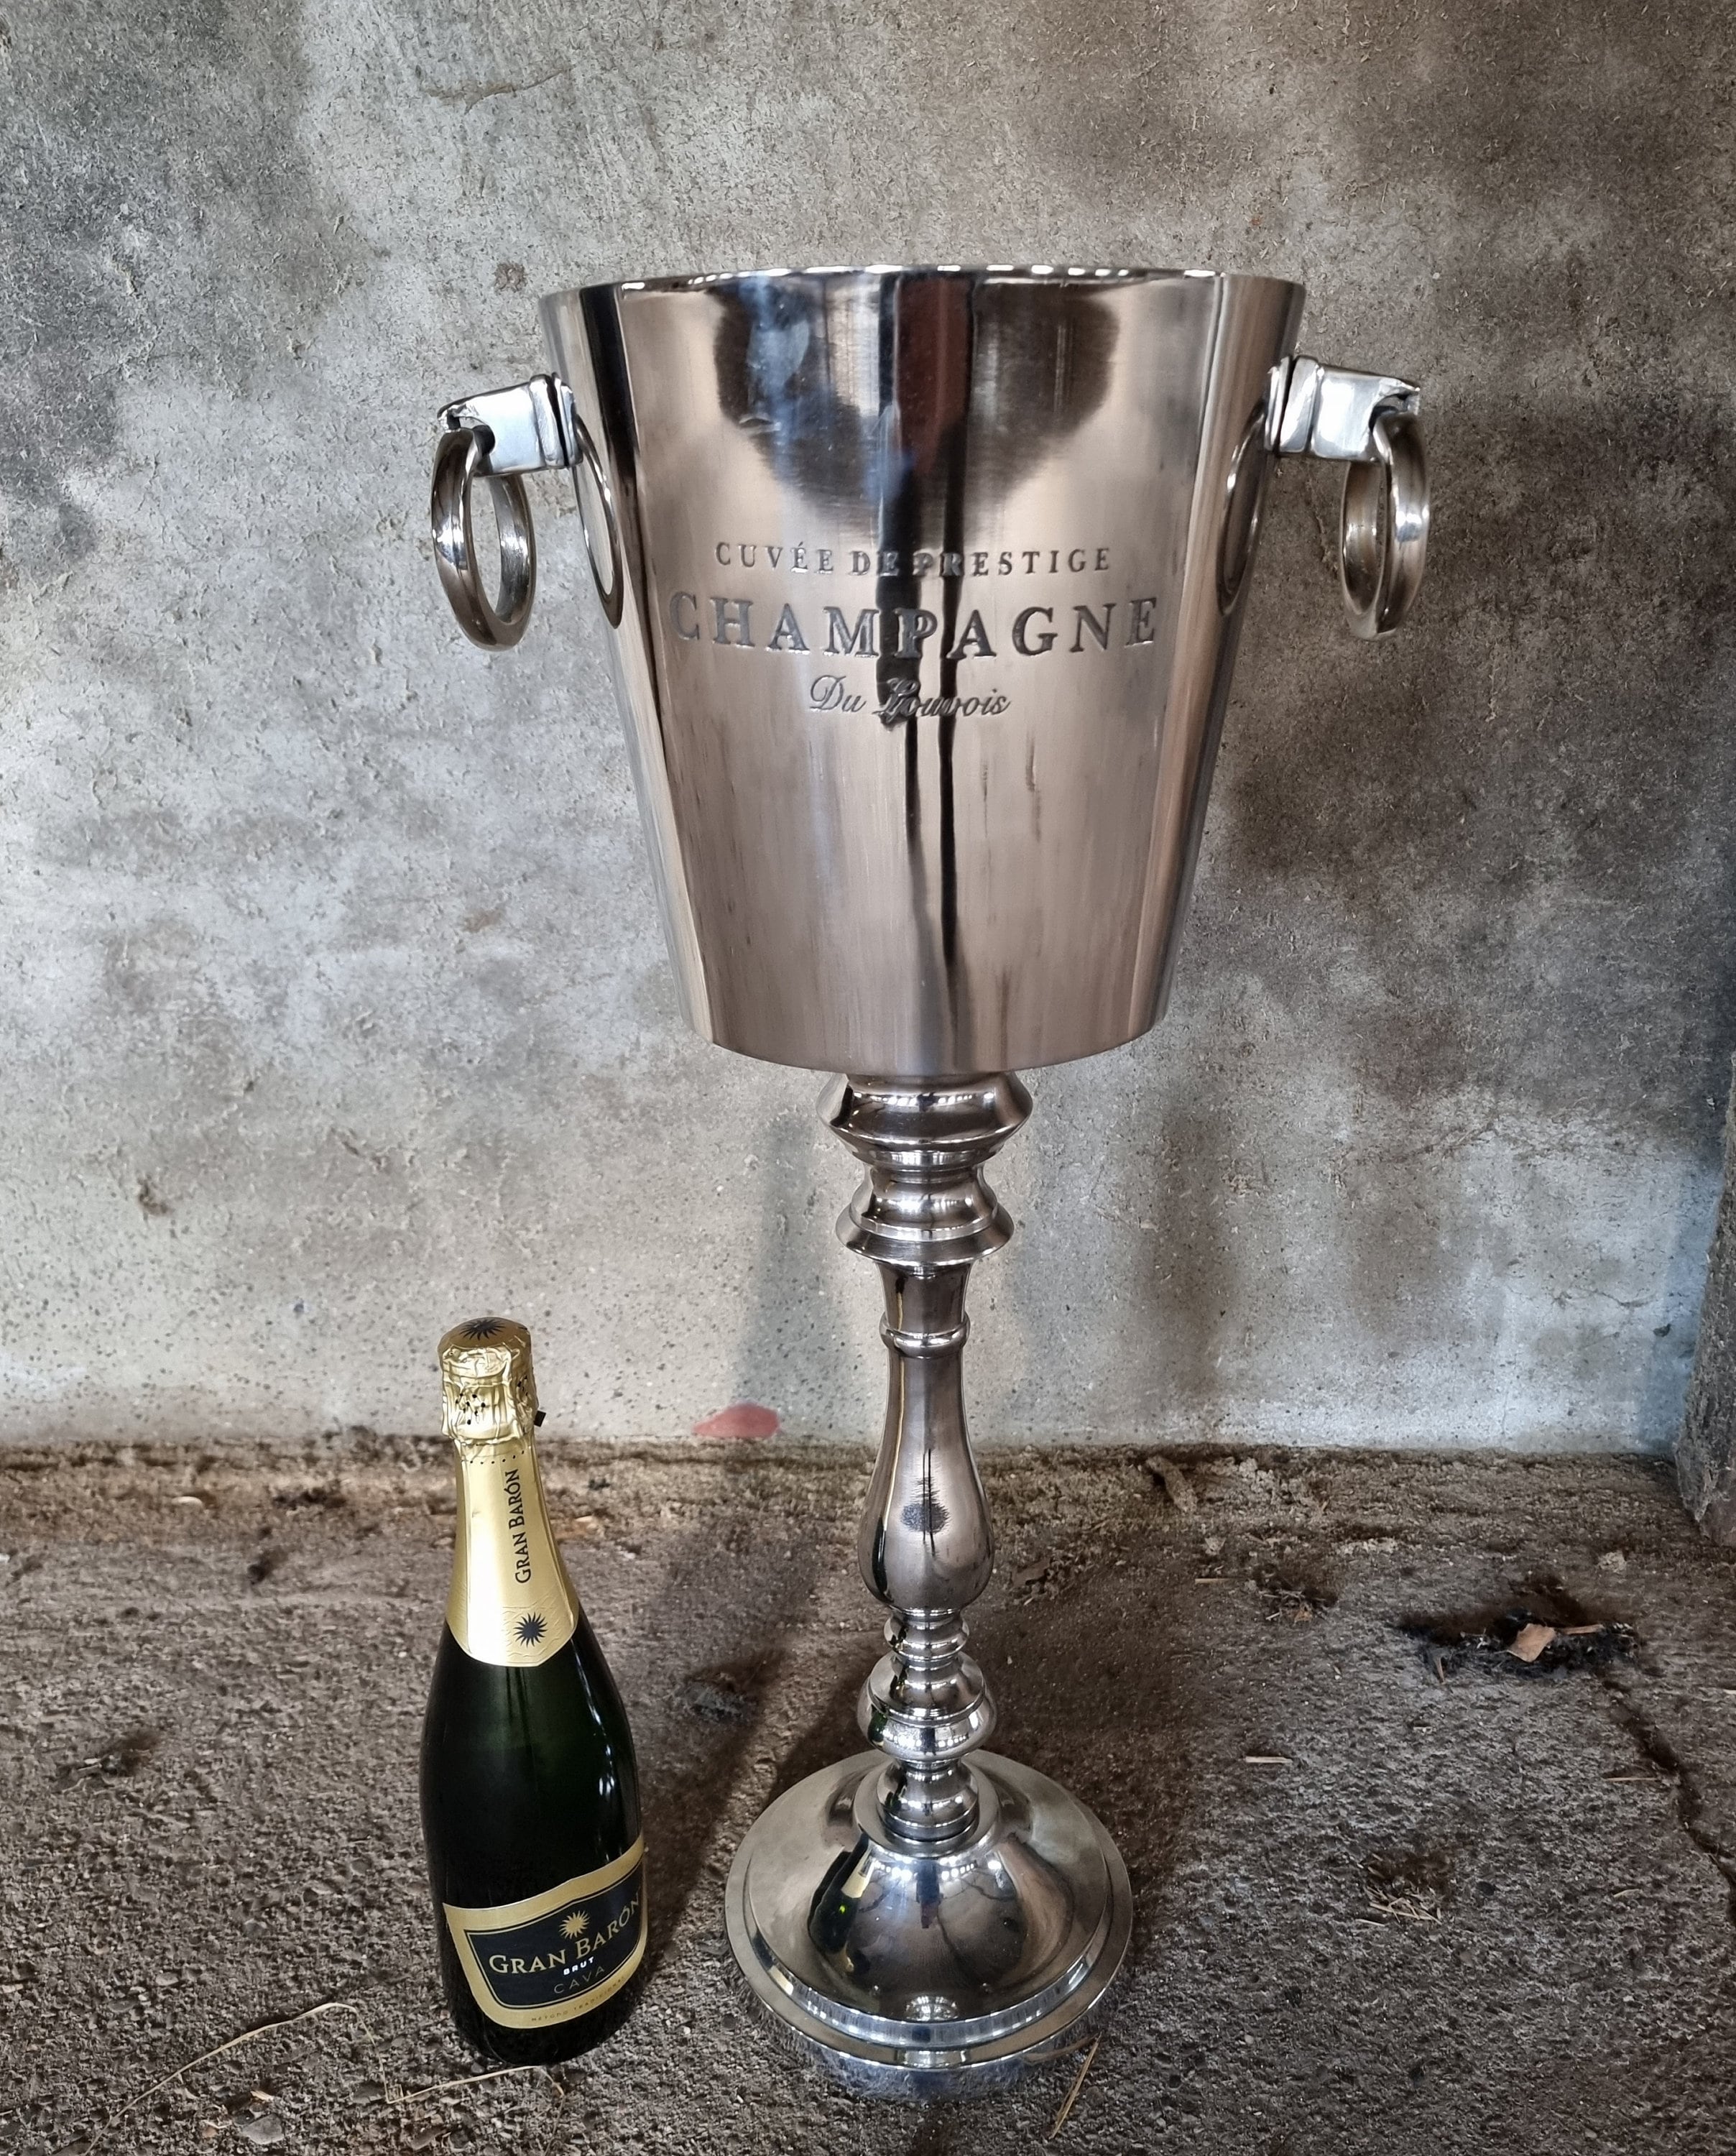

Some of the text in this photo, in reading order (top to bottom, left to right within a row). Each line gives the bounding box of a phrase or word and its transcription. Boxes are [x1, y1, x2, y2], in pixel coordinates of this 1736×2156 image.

[716, 542, 1109, 576] CUVÉE DE PRESTIGE
[669, 591, 1158, 658] CHAMPAGNE
[810, 674, 867, 712] Du
[504, 1468, 532, 1583] GRAN BARÓN
[489, 1890, 640, 1974] GRAN BARÓN
[553, 1966, 605, 1994] CAVA
[563, 1956, 595, 1975] BRUT
